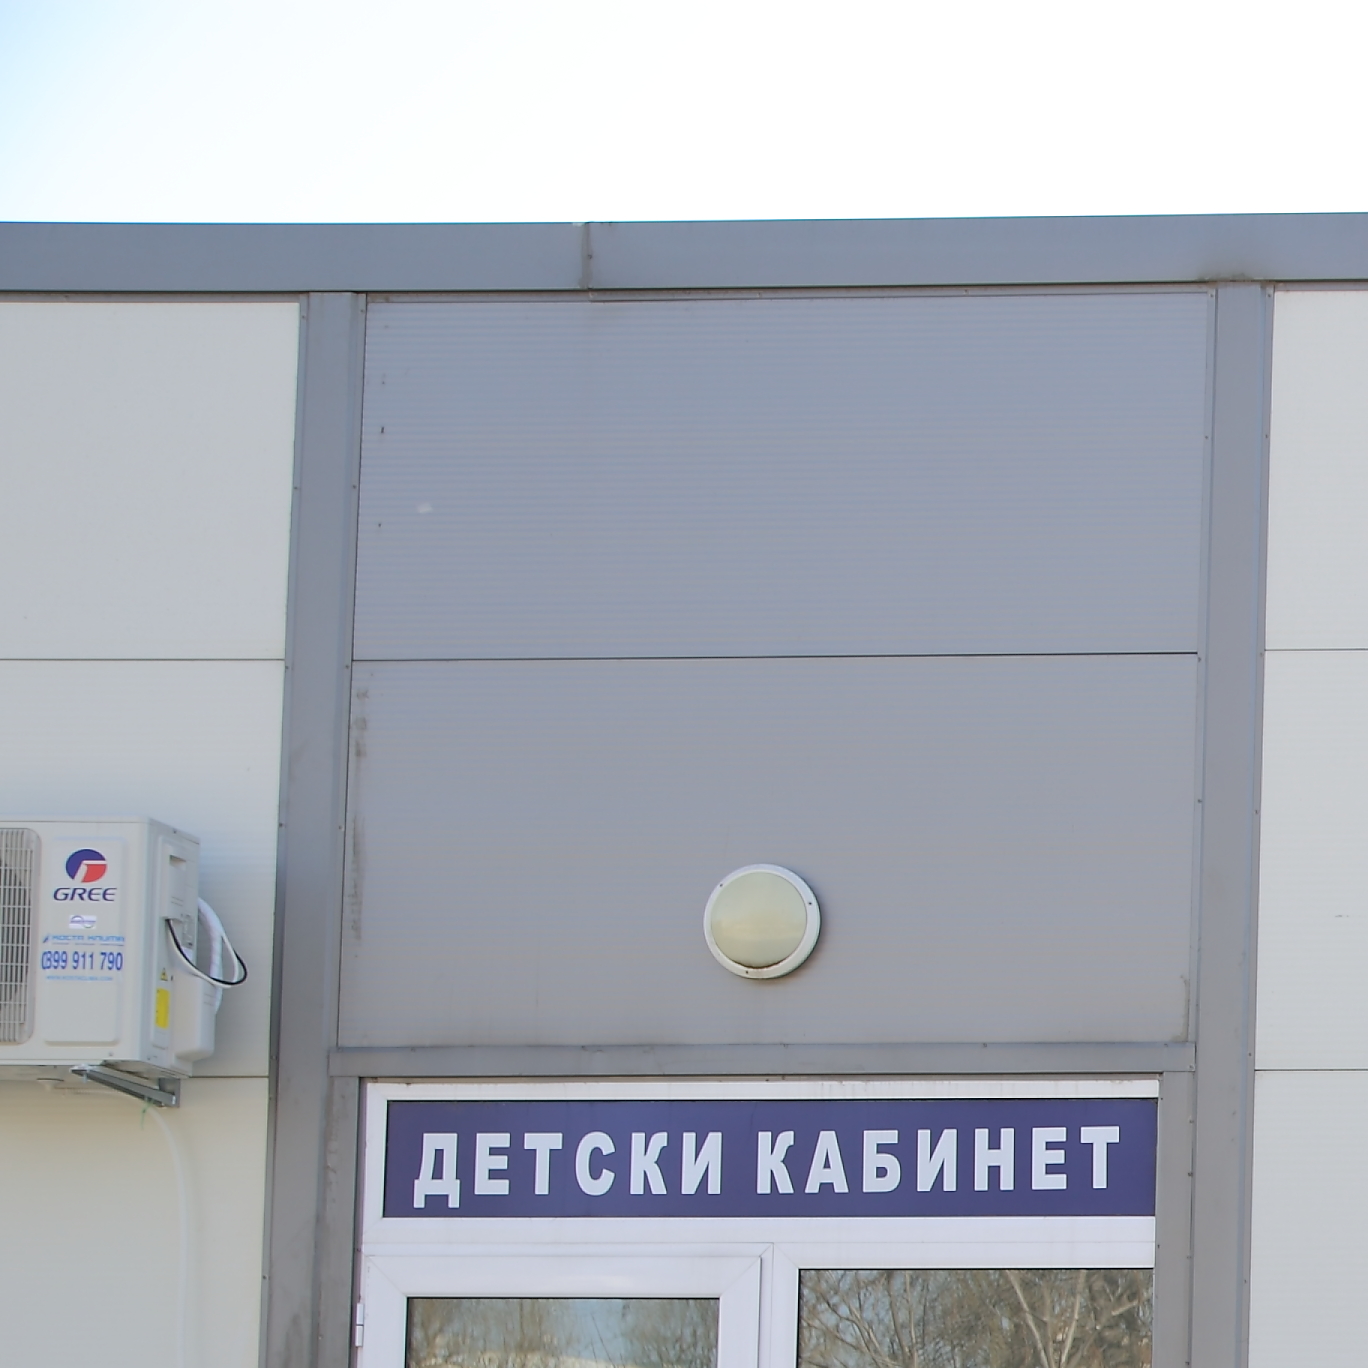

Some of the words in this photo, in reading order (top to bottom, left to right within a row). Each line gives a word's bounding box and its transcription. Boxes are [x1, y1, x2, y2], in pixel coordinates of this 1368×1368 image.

[53, 887, 117, 902] GREE
[72, 951, 94, 970] 911
[100, 951, 123, 971] 790
[412, 1130, 723, 1209] ДЕТСКИ
[755, 1125, 1121, 1194] КАБИНЕТ
